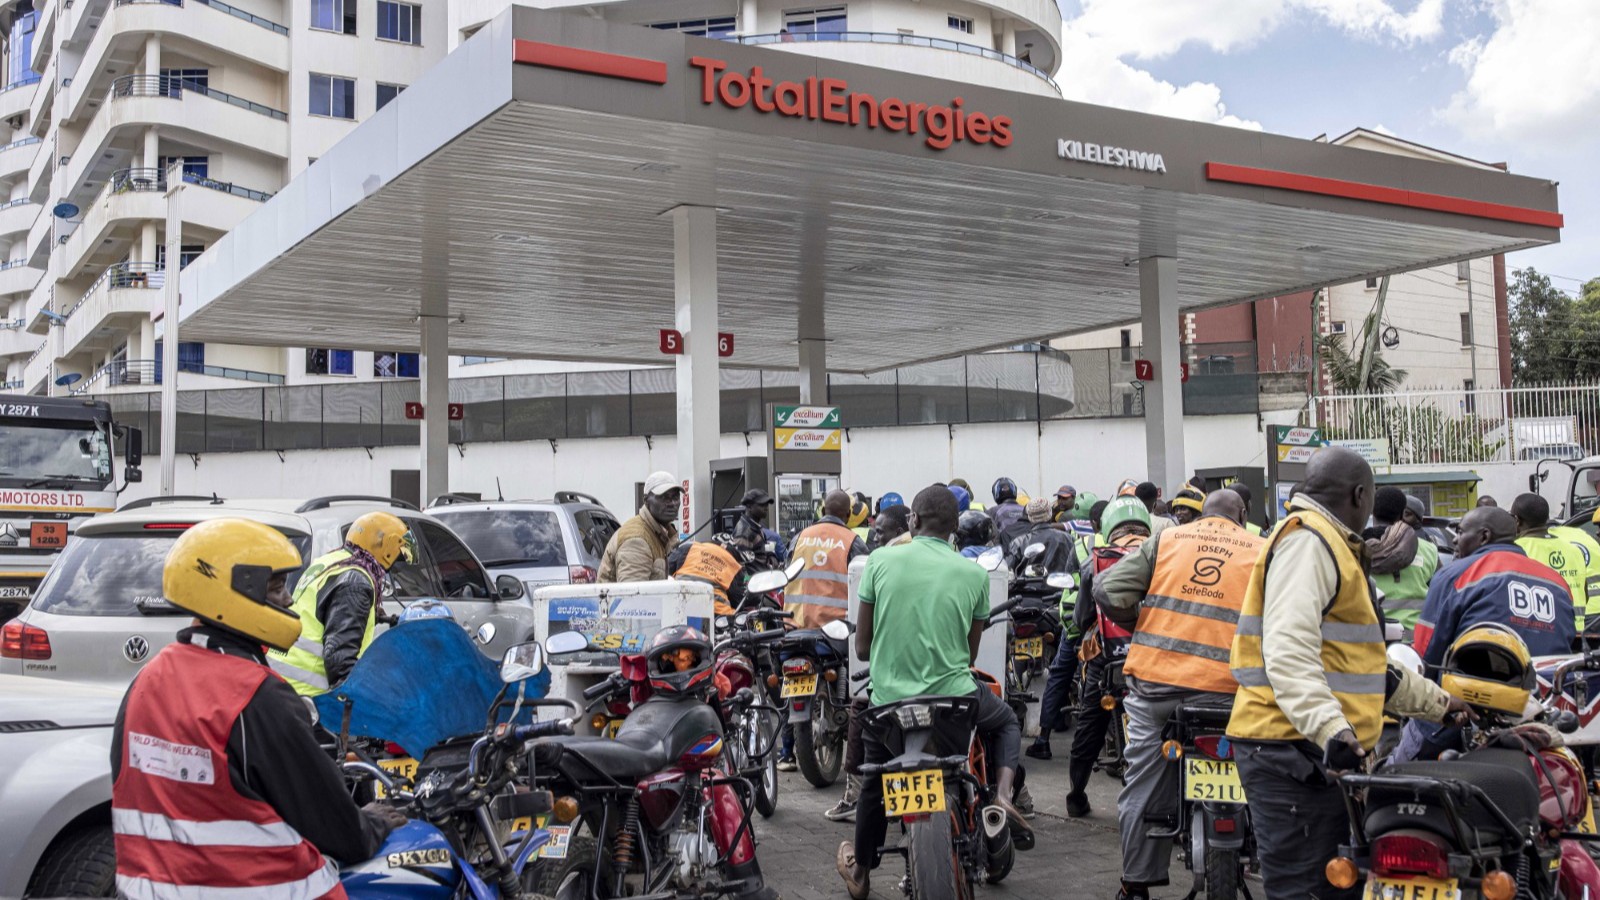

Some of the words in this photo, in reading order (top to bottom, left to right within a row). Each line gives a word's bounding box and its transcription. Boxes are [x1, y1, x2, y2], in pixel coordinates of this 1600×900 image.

[690, 56, 1014, 149] TotalEnergies
[1057, 138, 1167, 173] KILELESHWA
[667, 334, 676, 350] 5
[719, 337, 728, 352] 6
[1141, 364, 1148, 377] 7
[8, 405, 30, 416] 287
[31, 406, 39, 417] K
[411, 405, 417, 416] 1
[451, 406, 459, 418] 2
[799, 537, 846, 550] JUMIA
[1197, 545, 1233, 558] JOSEPH
[1181, 585, 1224, 599] SafeBoda
[1513, 588, 1550, 615] BM
[886, 774, 935, 795] KMFF
[1193, 783, 1242, 801] 521U
[889, 793, 937, 812] 379P
[1397, 803, 1427, 815] TVS
[386, 848, 450, 868] SKYGO
